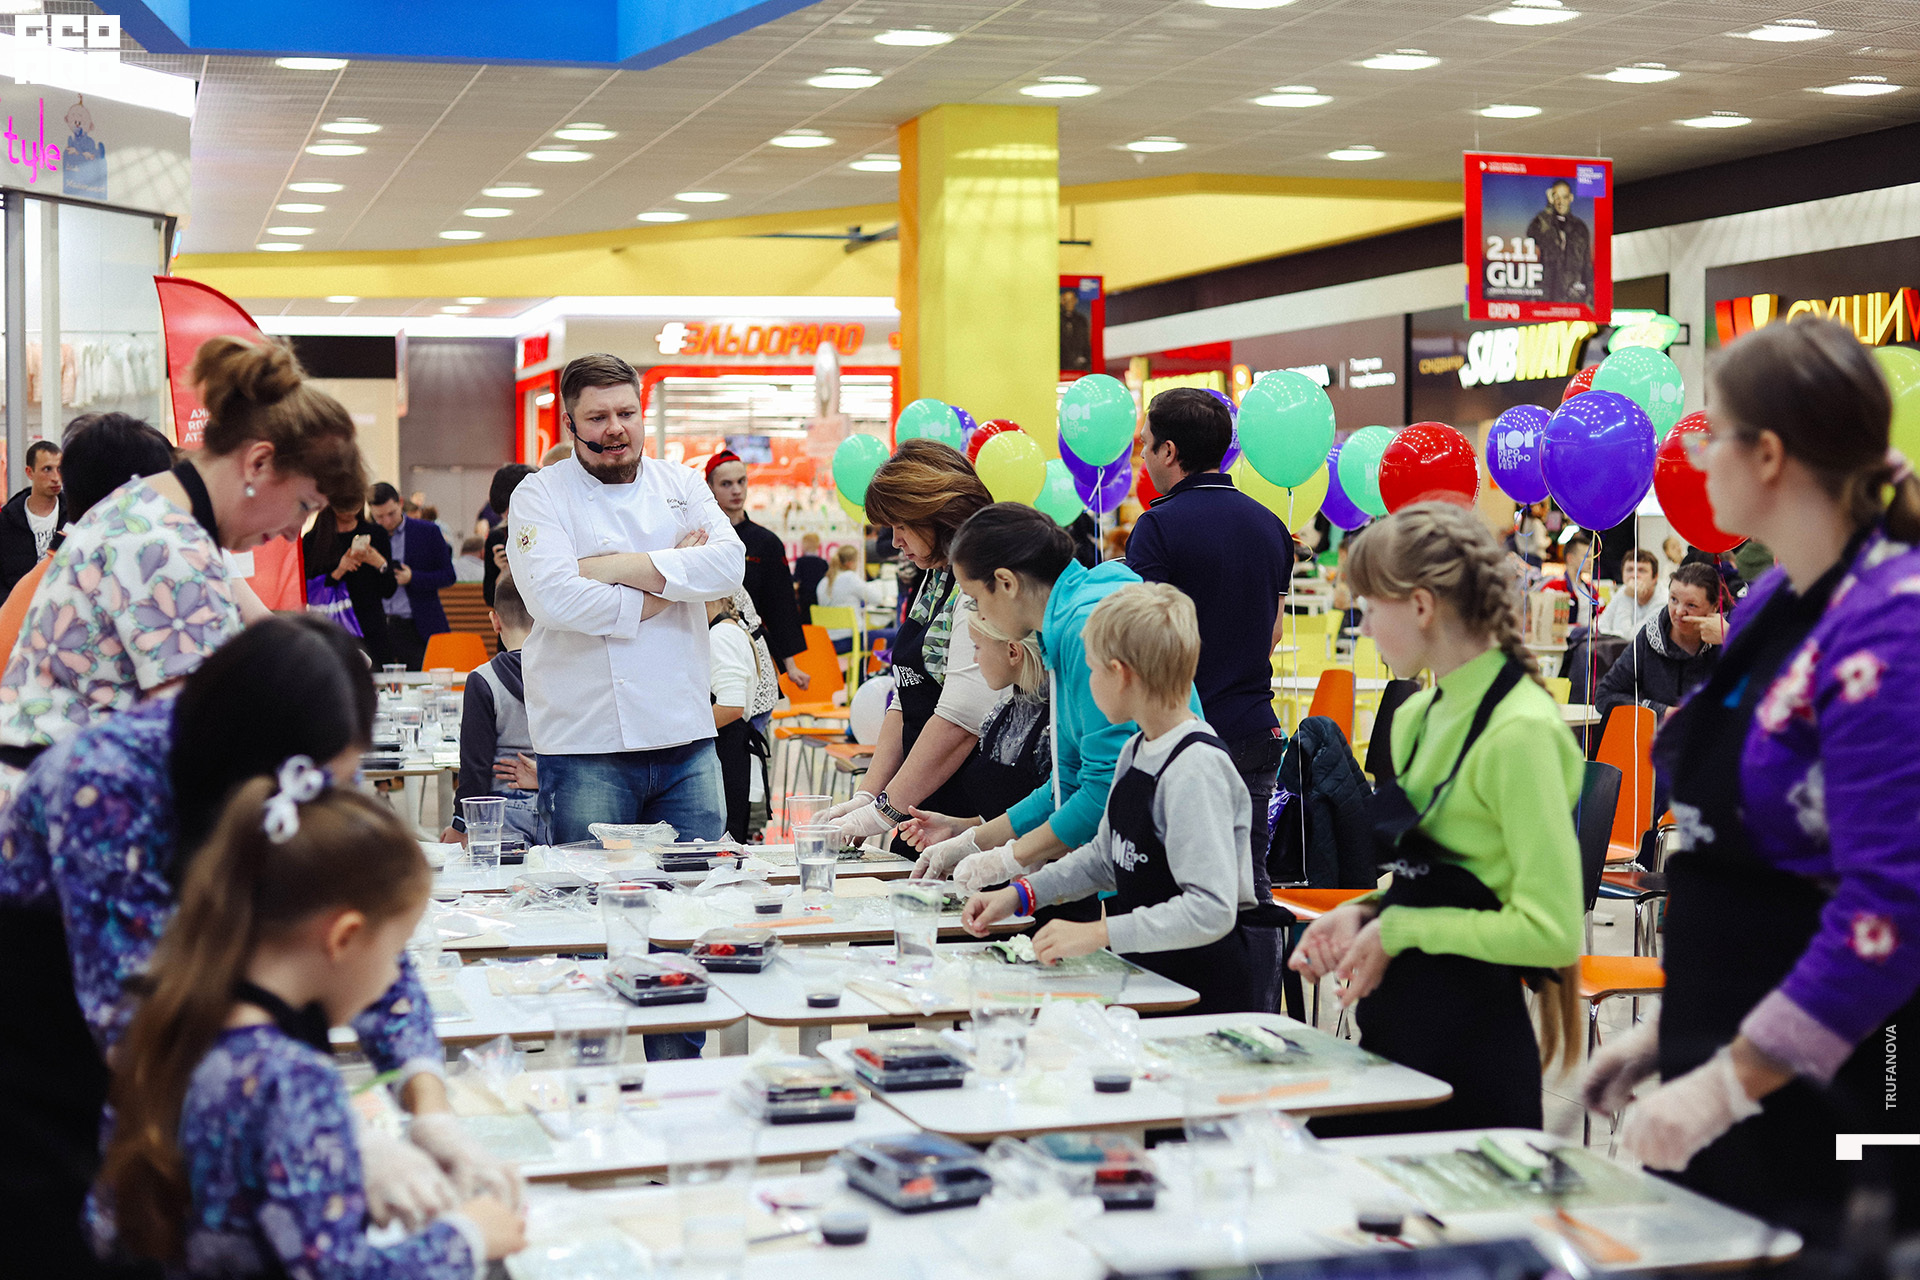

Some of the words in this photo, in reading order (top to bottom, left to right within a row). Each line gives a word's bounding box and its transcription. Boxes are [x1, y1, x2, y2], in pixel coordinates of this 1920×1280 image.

[0, 98, 61, 184] tyle
[1486, 235, 1538, 262] 2.11
[1486, 262, 1543, 288] GUF
[1458, 320, 1595, 388] SUBWAY
[1498, 448, 1520, 457] DEPO
